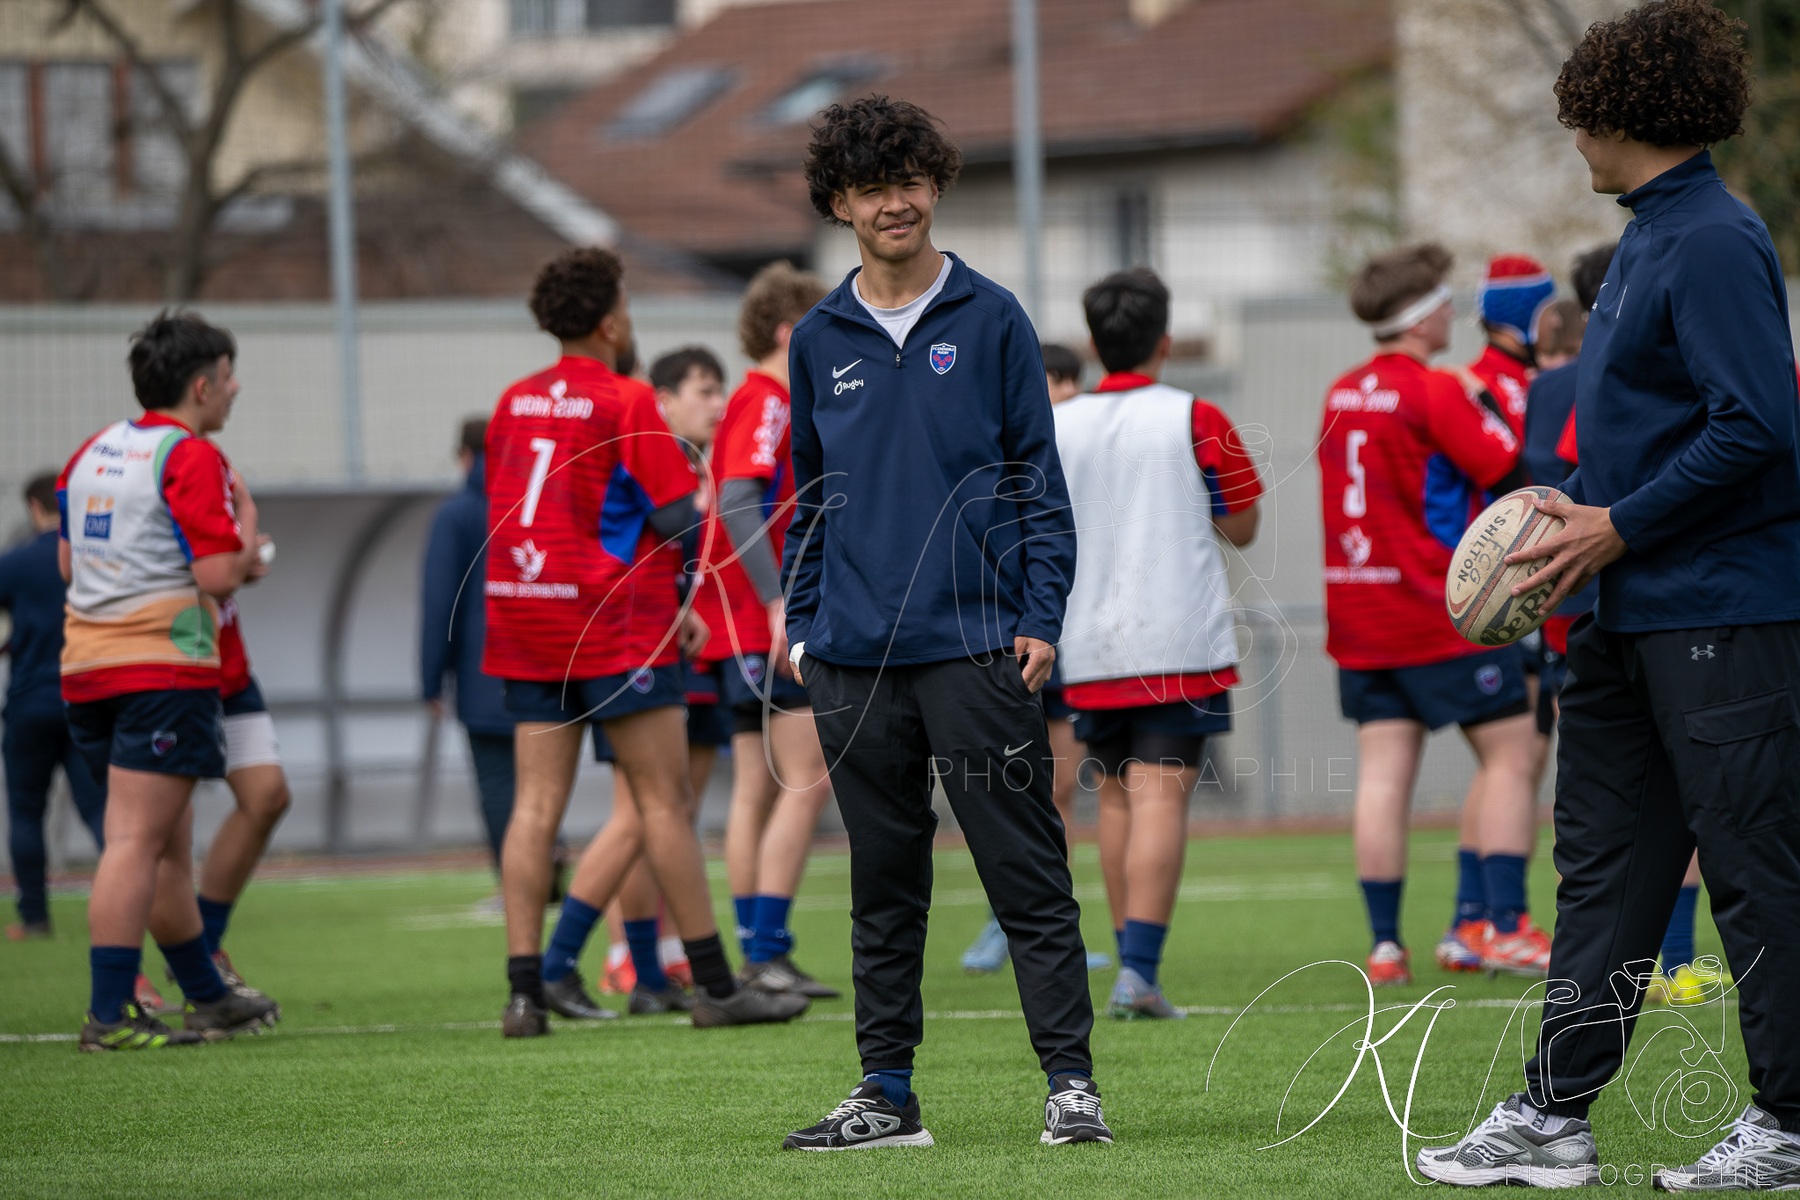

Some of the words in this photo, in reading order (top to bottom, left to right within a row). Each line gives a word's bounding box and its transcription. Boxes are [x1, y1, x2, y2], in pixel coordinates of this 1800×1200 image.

[519, 437, 556, 528] 7
[1343, 430, 1367, 518] 5
[1458, 515, 1507, 583] SHILTON
